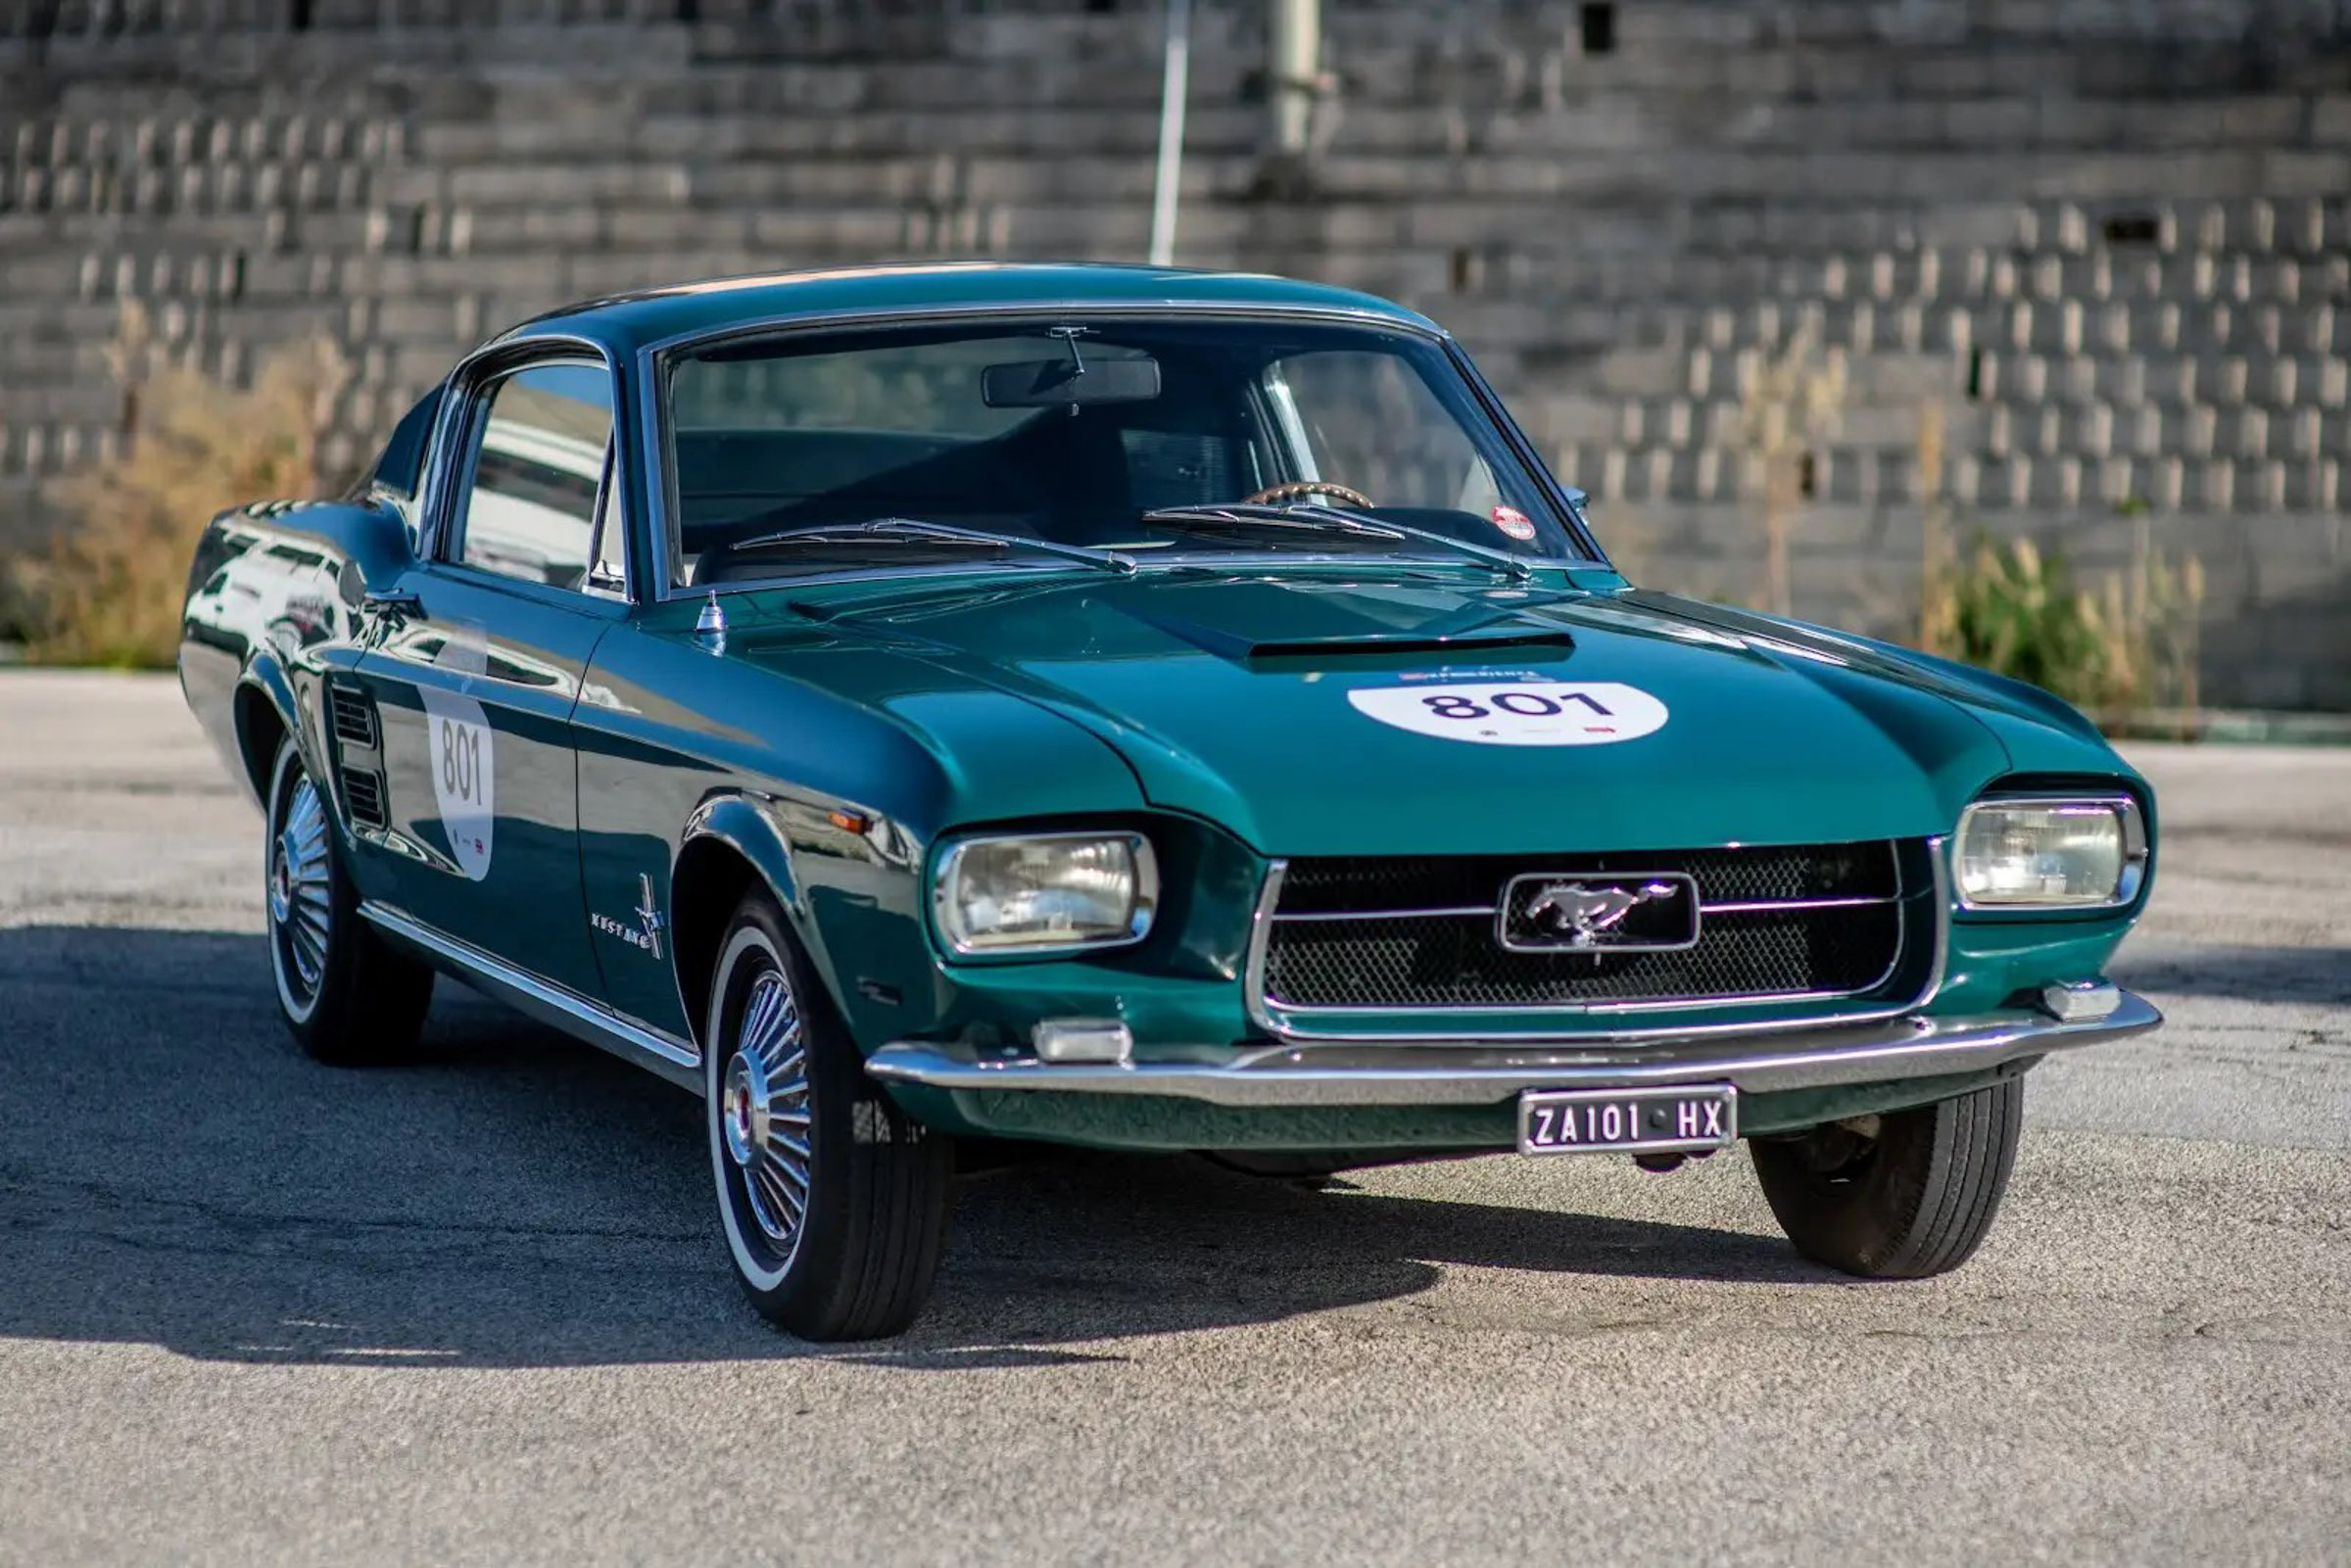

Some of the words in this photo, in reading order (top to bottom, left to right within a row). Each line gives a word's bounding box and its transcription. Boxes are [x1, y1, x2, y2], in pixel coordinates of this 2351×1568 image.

[1422, 692, 1614, 719] 801
[443, 719, 482, 806] 801
[1535, 1102, 1639, 1145] ZA101
[1678, 1101, 1722, 1138] HX
